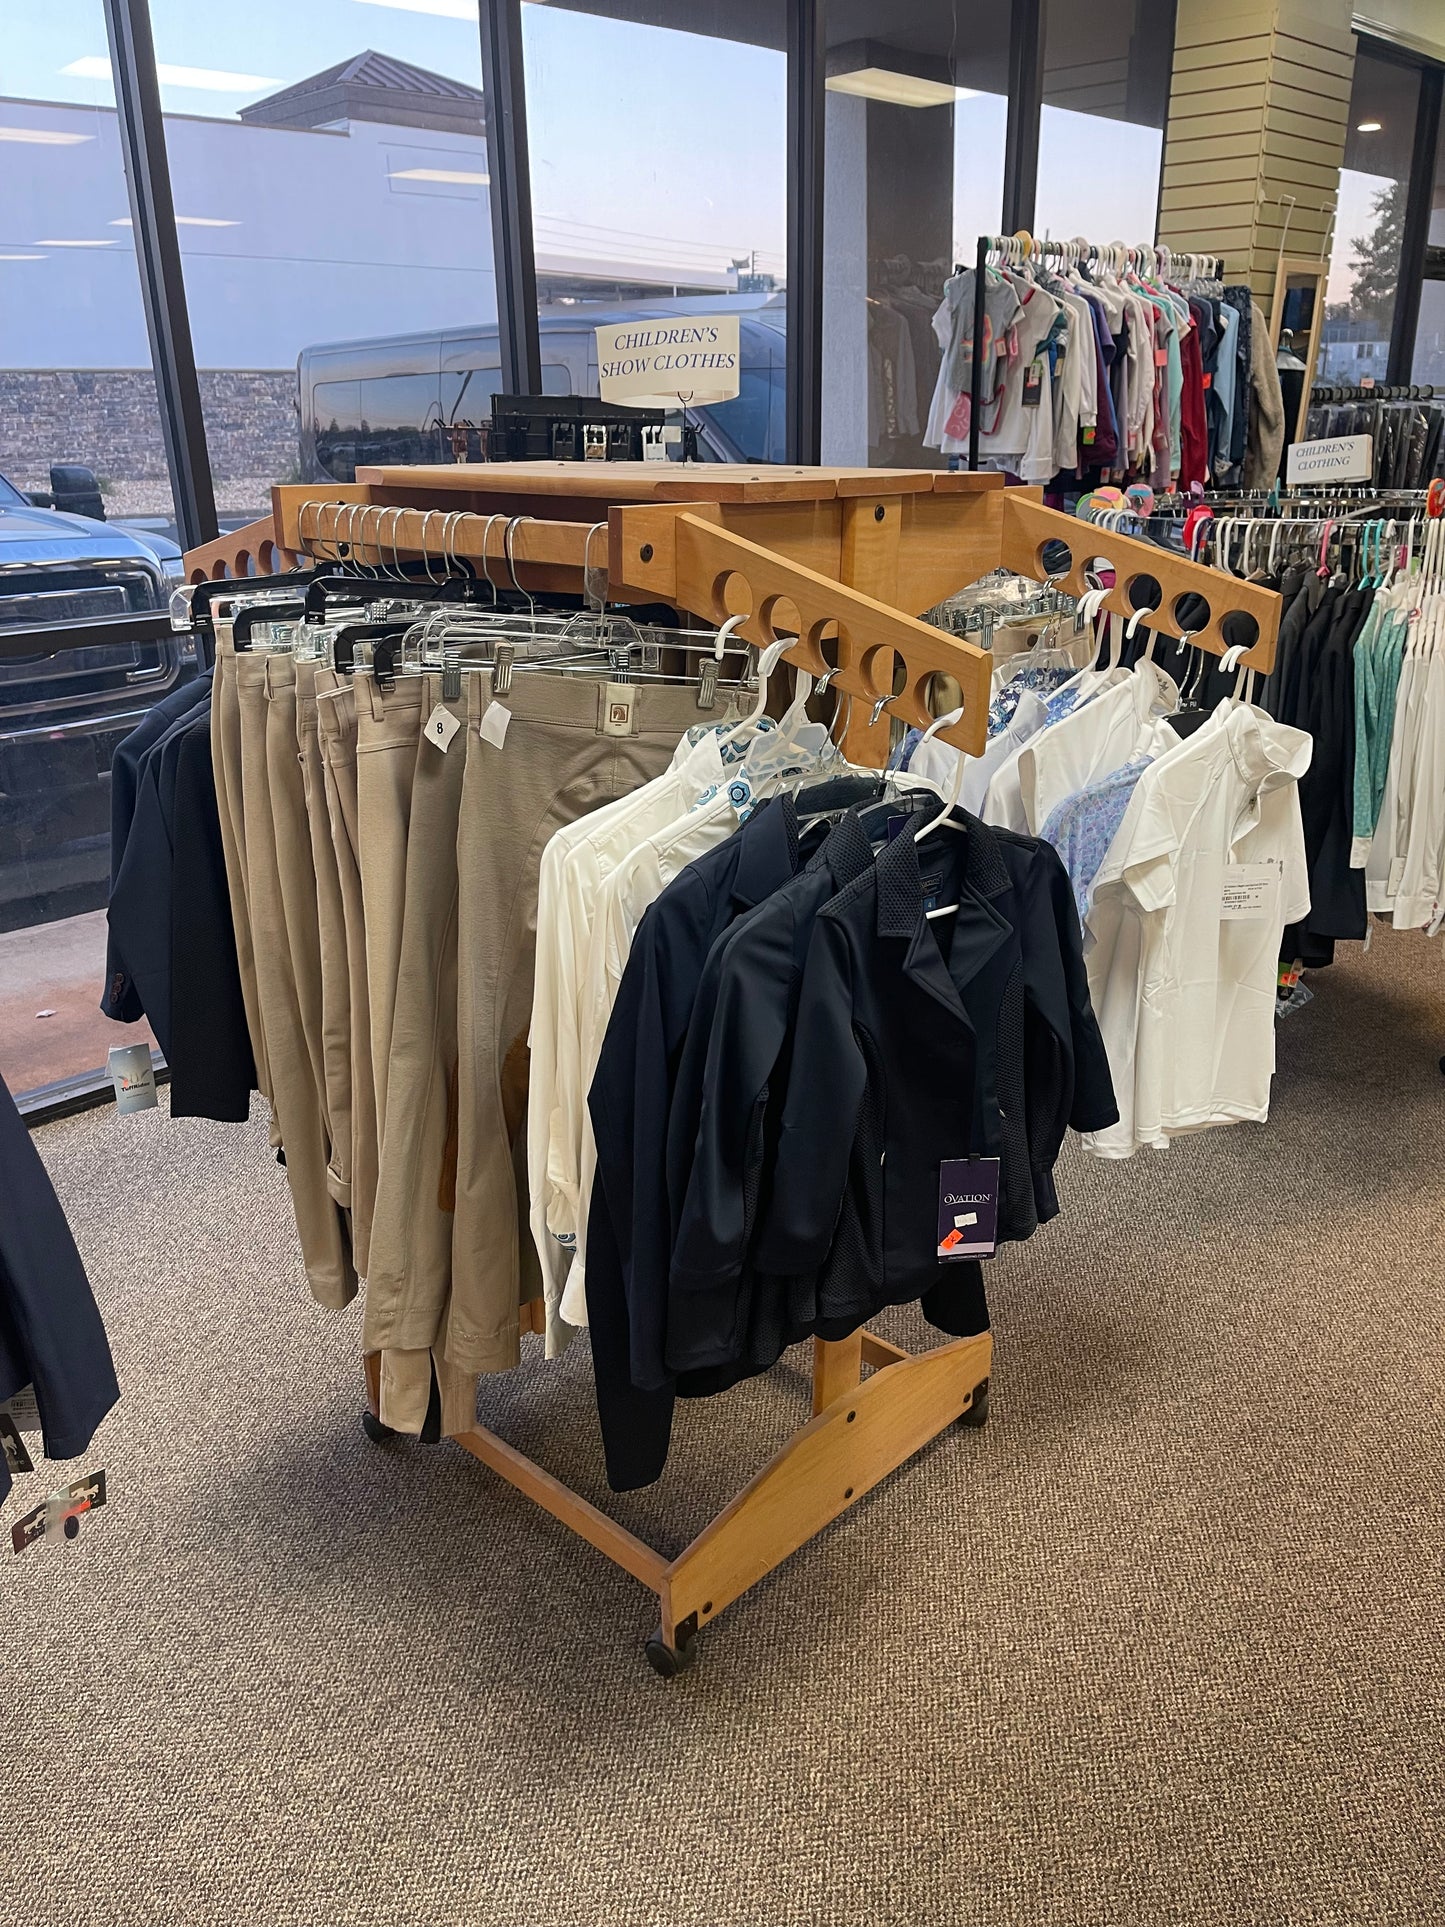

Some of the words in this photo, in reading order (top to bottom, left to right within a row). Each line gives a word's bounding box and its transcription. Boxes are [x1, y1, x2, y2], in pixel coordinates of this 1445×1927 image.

[614, 327, 719, 351] CHILDREN'S
[601, 357, 650, 378] SHOW
[653, 353, 736, 371] CLOTHES
[1296, 441, 1355, 458] CHILDREN'S
[1298, 456, 1351, 471] CLOTHING
[436, 722, 444, 735] 8
[944, 1193, 991, 1205] OVATION
